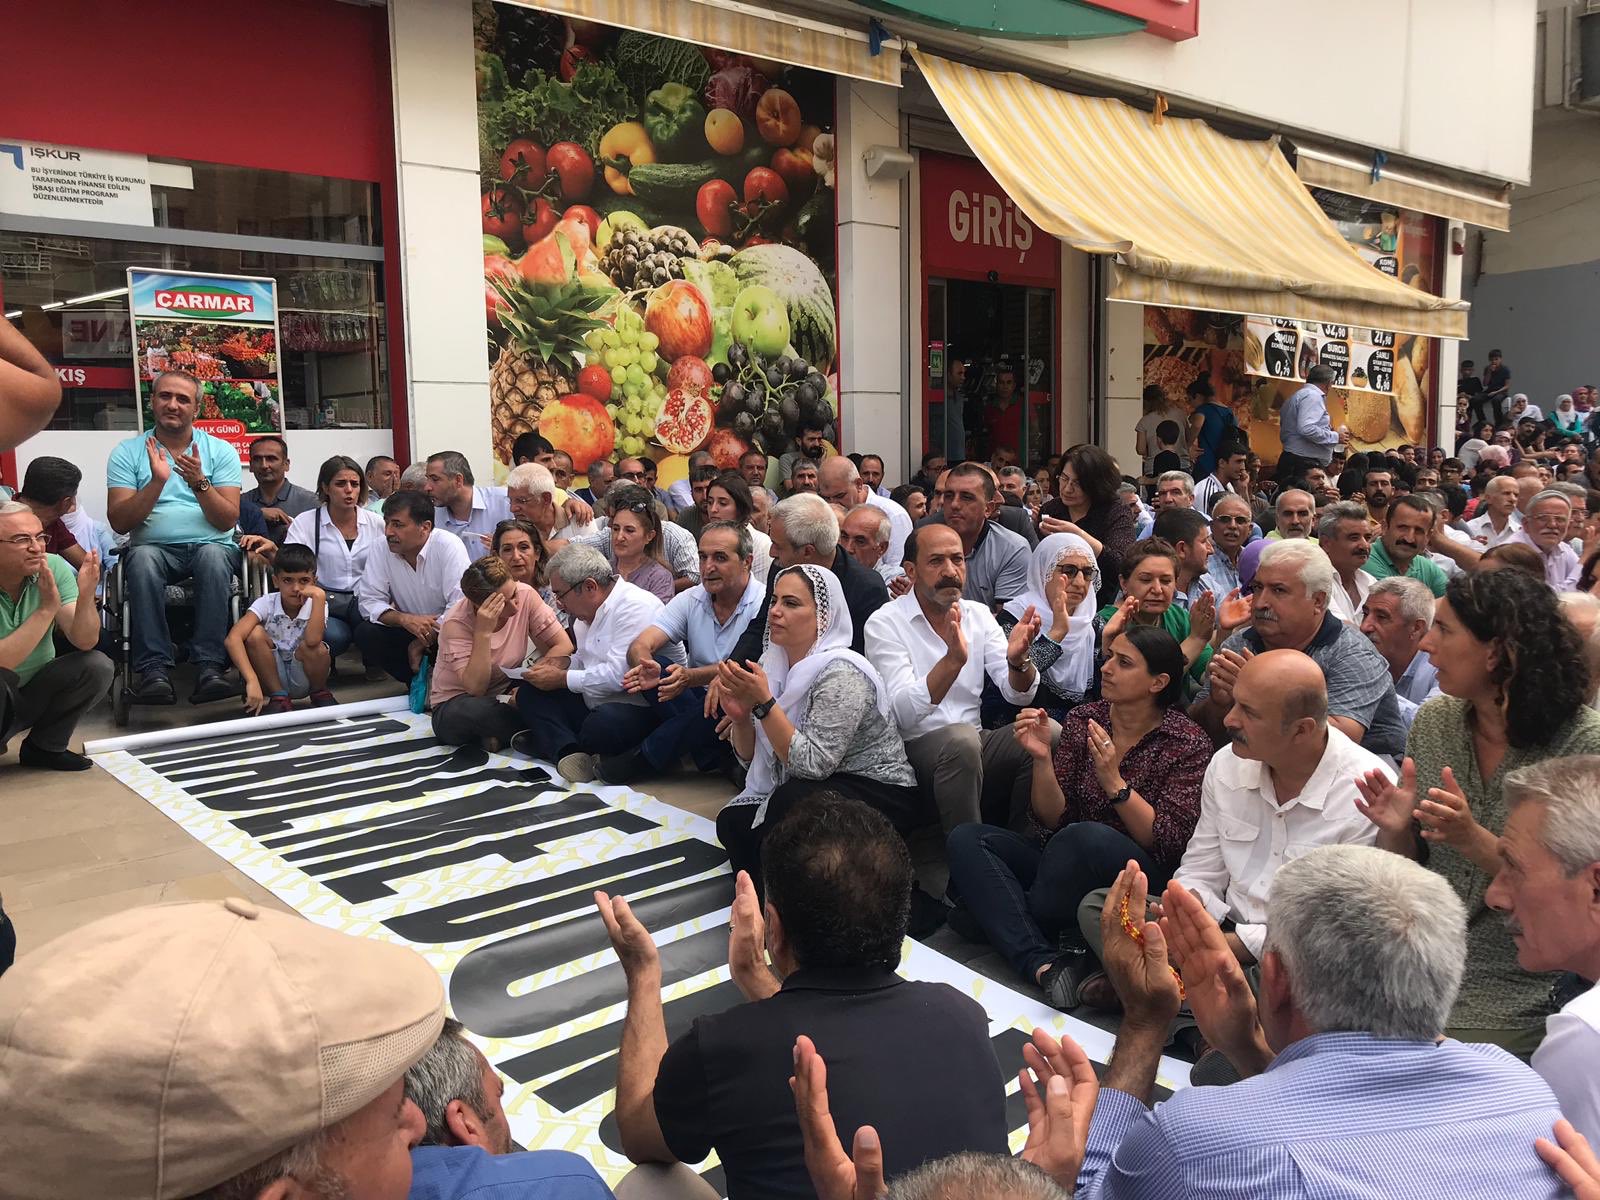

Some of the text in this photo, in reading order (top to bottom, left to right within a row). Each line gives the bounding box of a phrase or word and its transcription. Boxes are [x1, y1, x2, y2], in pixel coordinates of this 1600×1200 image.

[31, 175, 131, 192] TARAFINDAN FİNANSE EDİLEN
[42, 167, 78, 178] İŞYERİNDE
[78, 171, 107, 181] TÜRKİYE
[107, 174, 115, 183] İŞ
[115, 175, 146, 185] KURUMU
[32, 184, 119, 199] İŞBAŞI EĞİTİM PROGRAMI
[33, 193, 104, 206] DÜZENLENMEKTEDİR
[156, 292, 252, 313] CARMAR
[54, 368, 86, 386] KIŞ
[216, 425, 240, 434] GÜNÜ
